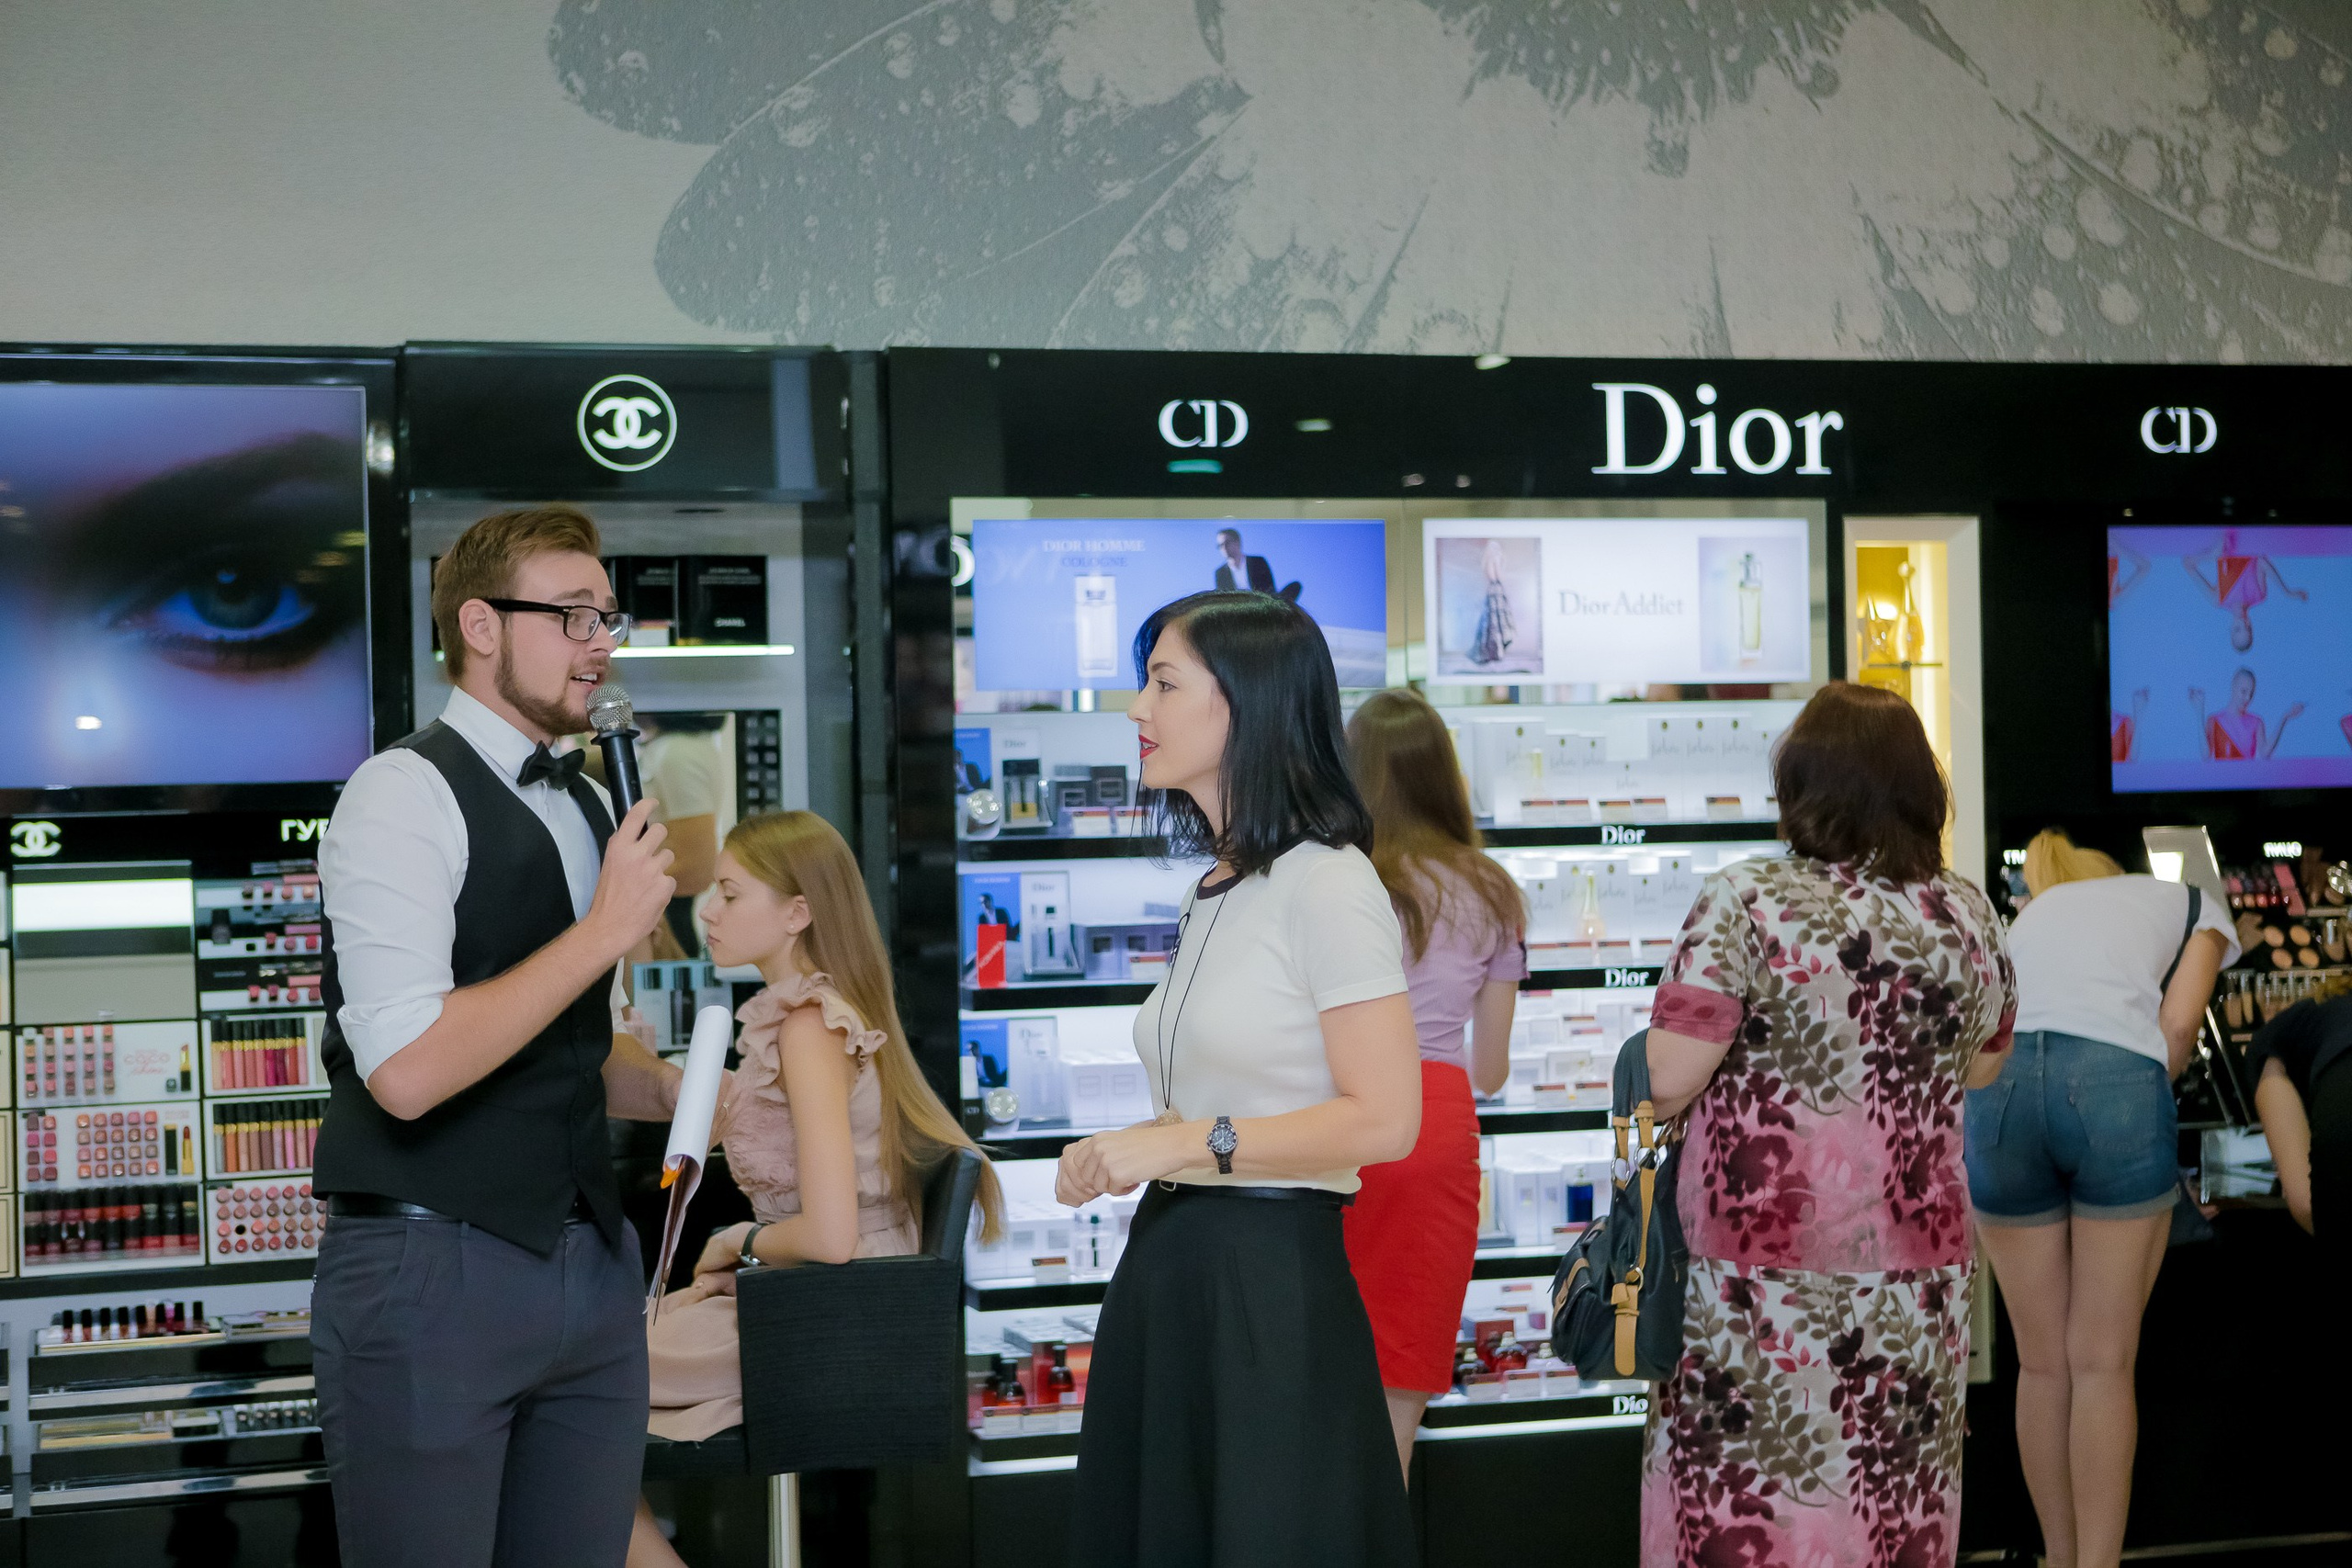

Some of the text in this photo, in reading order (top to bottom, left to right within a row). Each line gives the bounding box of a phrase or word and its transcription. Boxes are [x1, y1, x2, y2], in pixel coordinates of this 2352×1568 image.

[1158, 399, 1250, 448] CD
[1590, 382, 1844, 476] Dior
[2140, 406, 2218, 454] CD
[1043, 539, 1147, 552] DIOR HOMME
[1060, 556, 1129, 568] COLOGNE
[1557, 589, 1684, 615] Dior Addict
[1600, 825, 1645, 845] Dior
[1604, 967, 1649, 988] Dior
[1612, 1394, 1649, 1415] Dio
